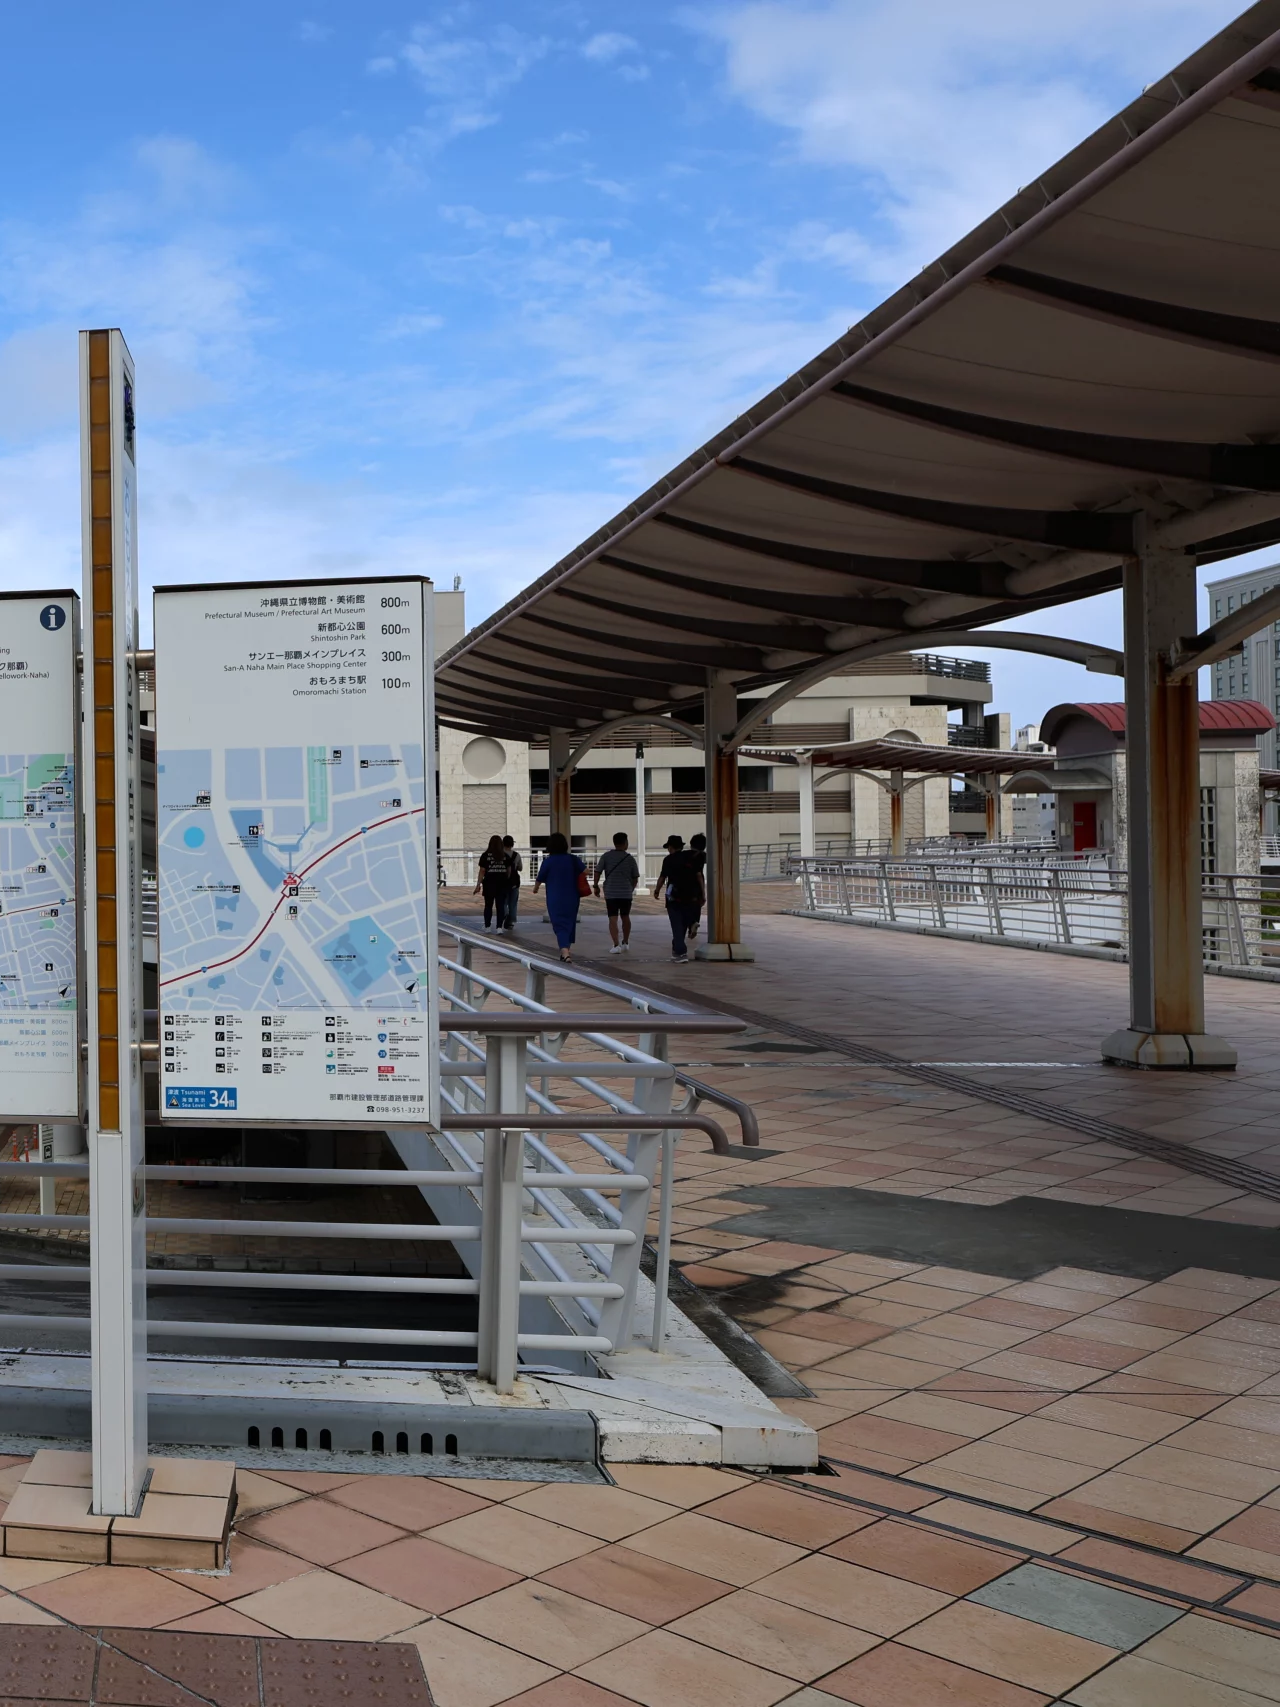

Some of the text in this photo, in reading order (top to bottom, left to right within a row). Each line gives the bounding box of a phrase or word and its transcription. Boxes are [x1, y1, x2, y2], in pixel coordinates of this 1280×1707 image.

[260, 594, 366, 608] 沖縄県立博物館・美術館
[381, 597, 410, 608] 800m
[204, 611, 242, 620] Prefectural
[244, 610, 275, 618] Museum
[281, 608, 319, 616] Prefectural
[334, 606, 366, 614] Museum
[318, 622, 366, 632] 新都心公園
[381, 624, 410, 635] 600m
[310, 634, 348, 642] Shintoshin
[248, 649, 366, 661] サンエー那覇メインプレイス
[382, 651, 411, 662] 300m
[224, 664, 244, 672] San-A
[307, 660, 341, 670] Shopping
[343, 660, 367, 668] Center
[310, 676, 367, 686] おもろまち駅
[382, 678, 411, 689] 100m
[292, 687, 367, 696] Omoromachi Station
